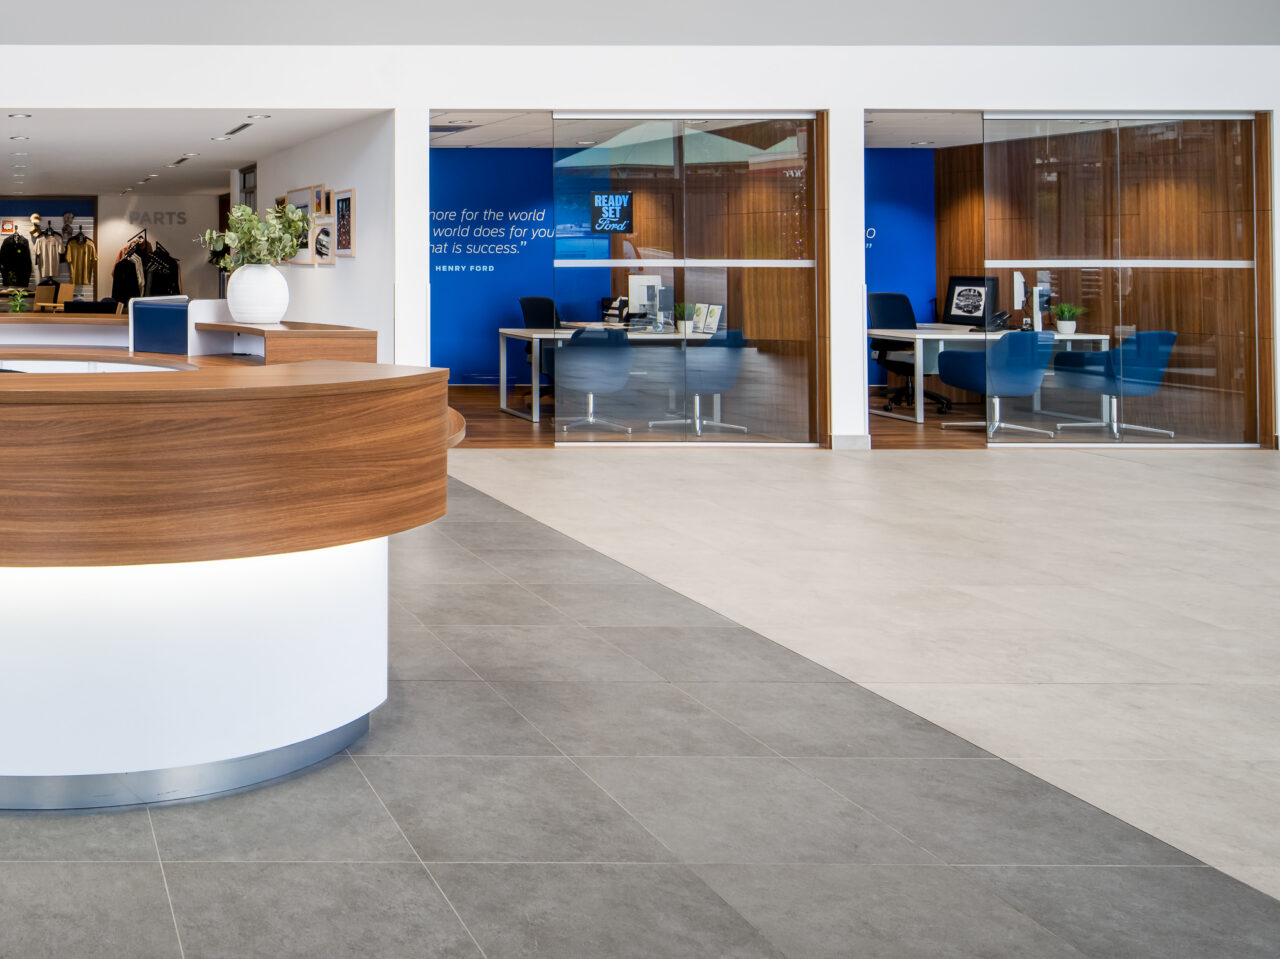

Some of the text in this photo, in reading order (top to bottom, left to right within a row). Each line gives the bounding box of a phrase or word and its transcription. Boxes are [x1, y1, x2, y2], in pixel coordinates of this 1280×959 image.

[595, 194, 629, 207] READY
[129, 211, 187, 225] PARTS
[460, 208, 478, 223] for
[483, 209, 504, 221] the
[508, 209, 546, 221] world
[602, 206, 621, 218] SET
[595, 217, 626, 230] Ford
[433, 225, 554, 239] world does for you
[451, 242, 462, 254] is
